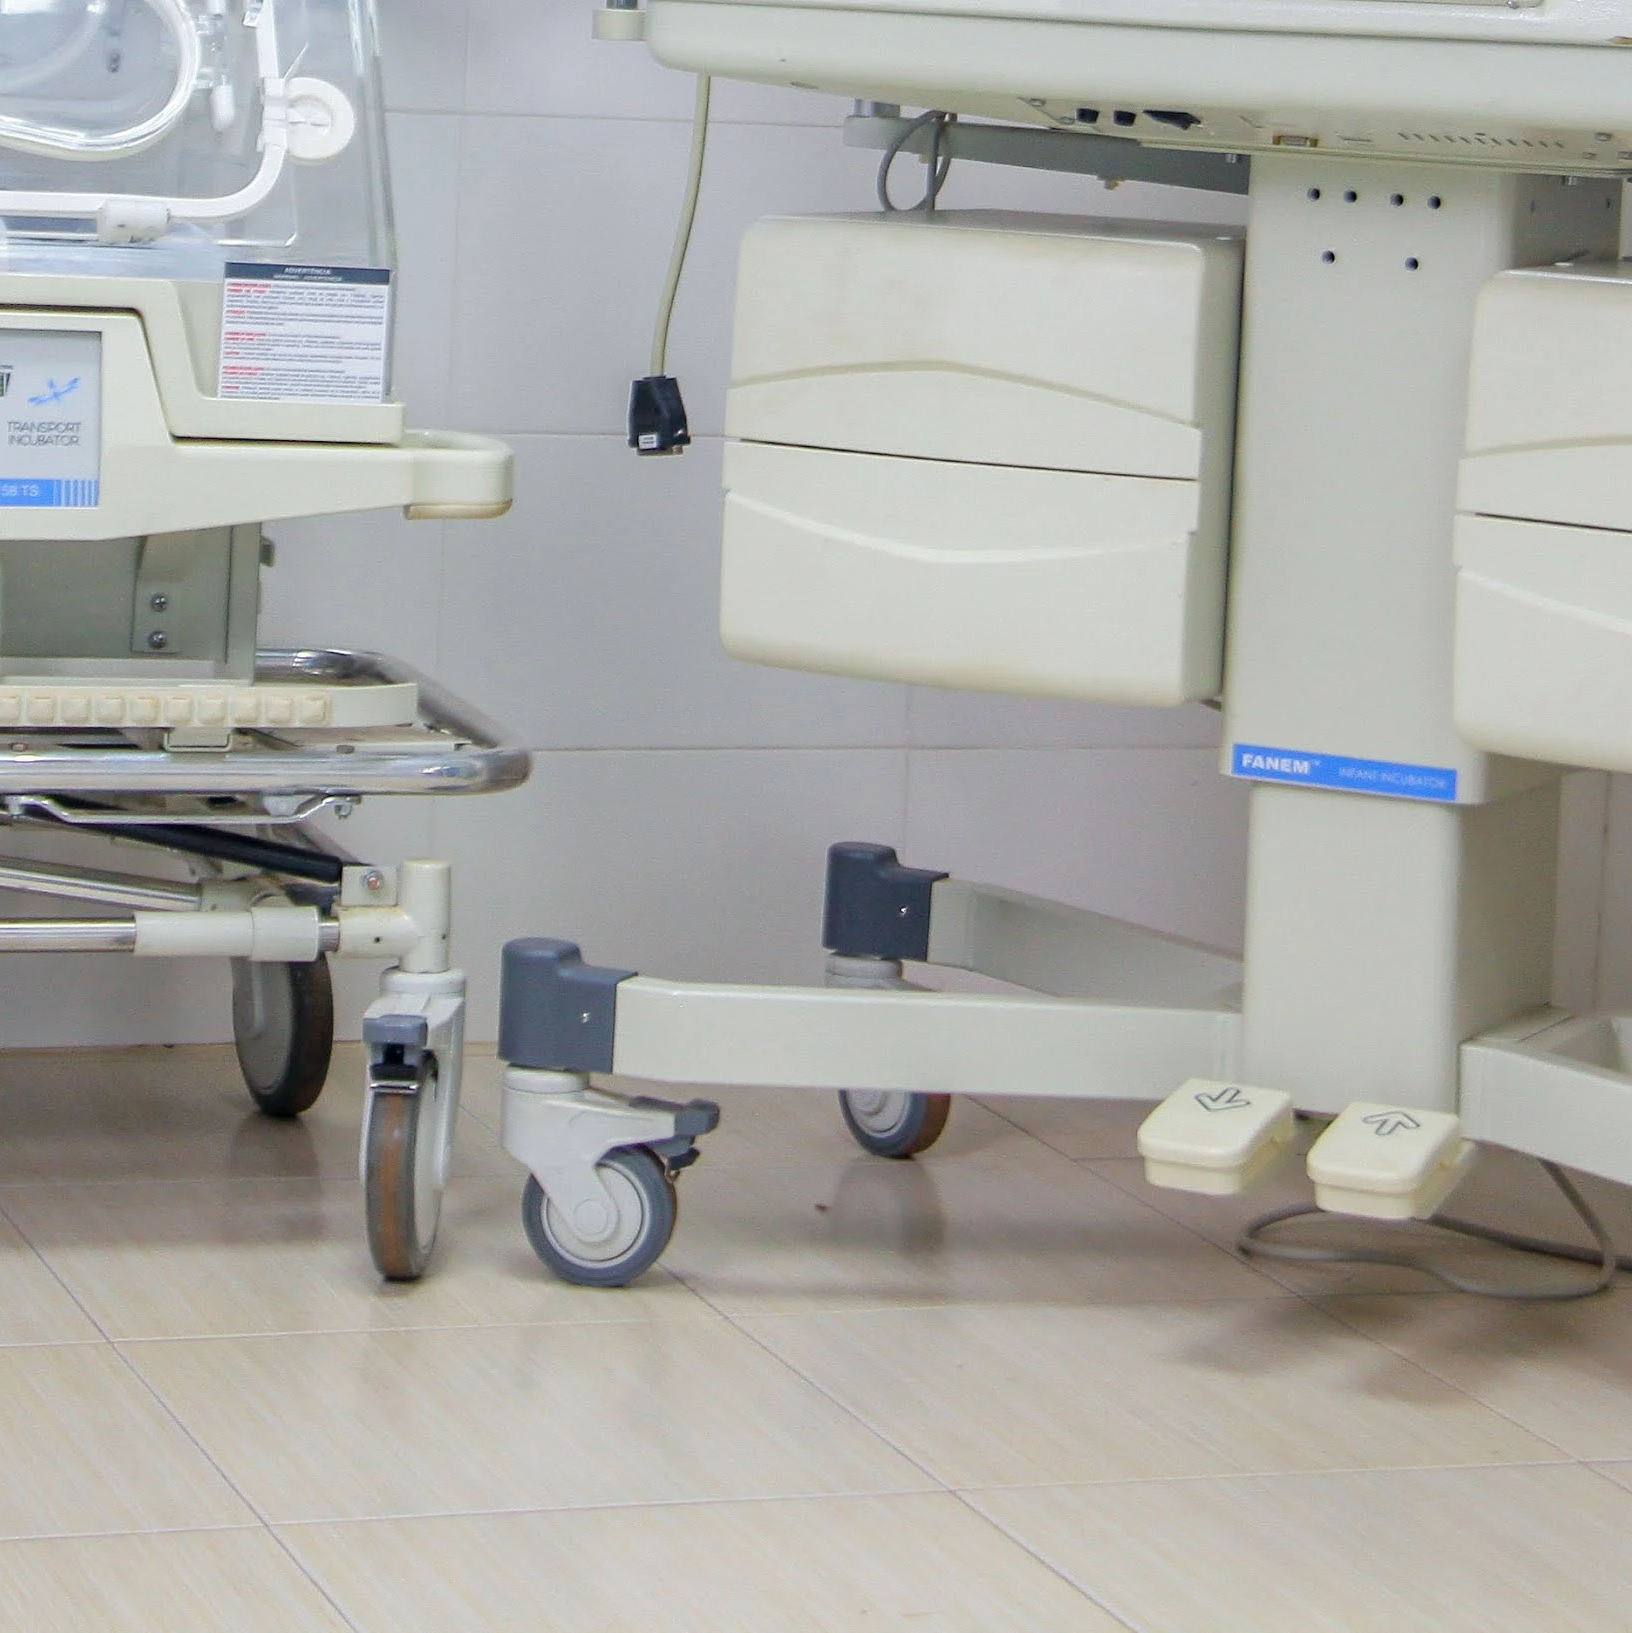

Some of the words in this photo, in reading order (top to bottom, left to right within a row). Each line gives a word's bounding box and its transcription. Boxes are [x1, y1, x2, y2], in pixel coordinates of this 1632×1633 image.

[7, 421, 82, 433] TRANSPORT
[7, 434, 81, 447] INCUBATOR
[20, 485, 40, 498] TS
[1338, 766, 1379, 781] INFANT
[1381, 770, 1448, 789] INCUBATOR
